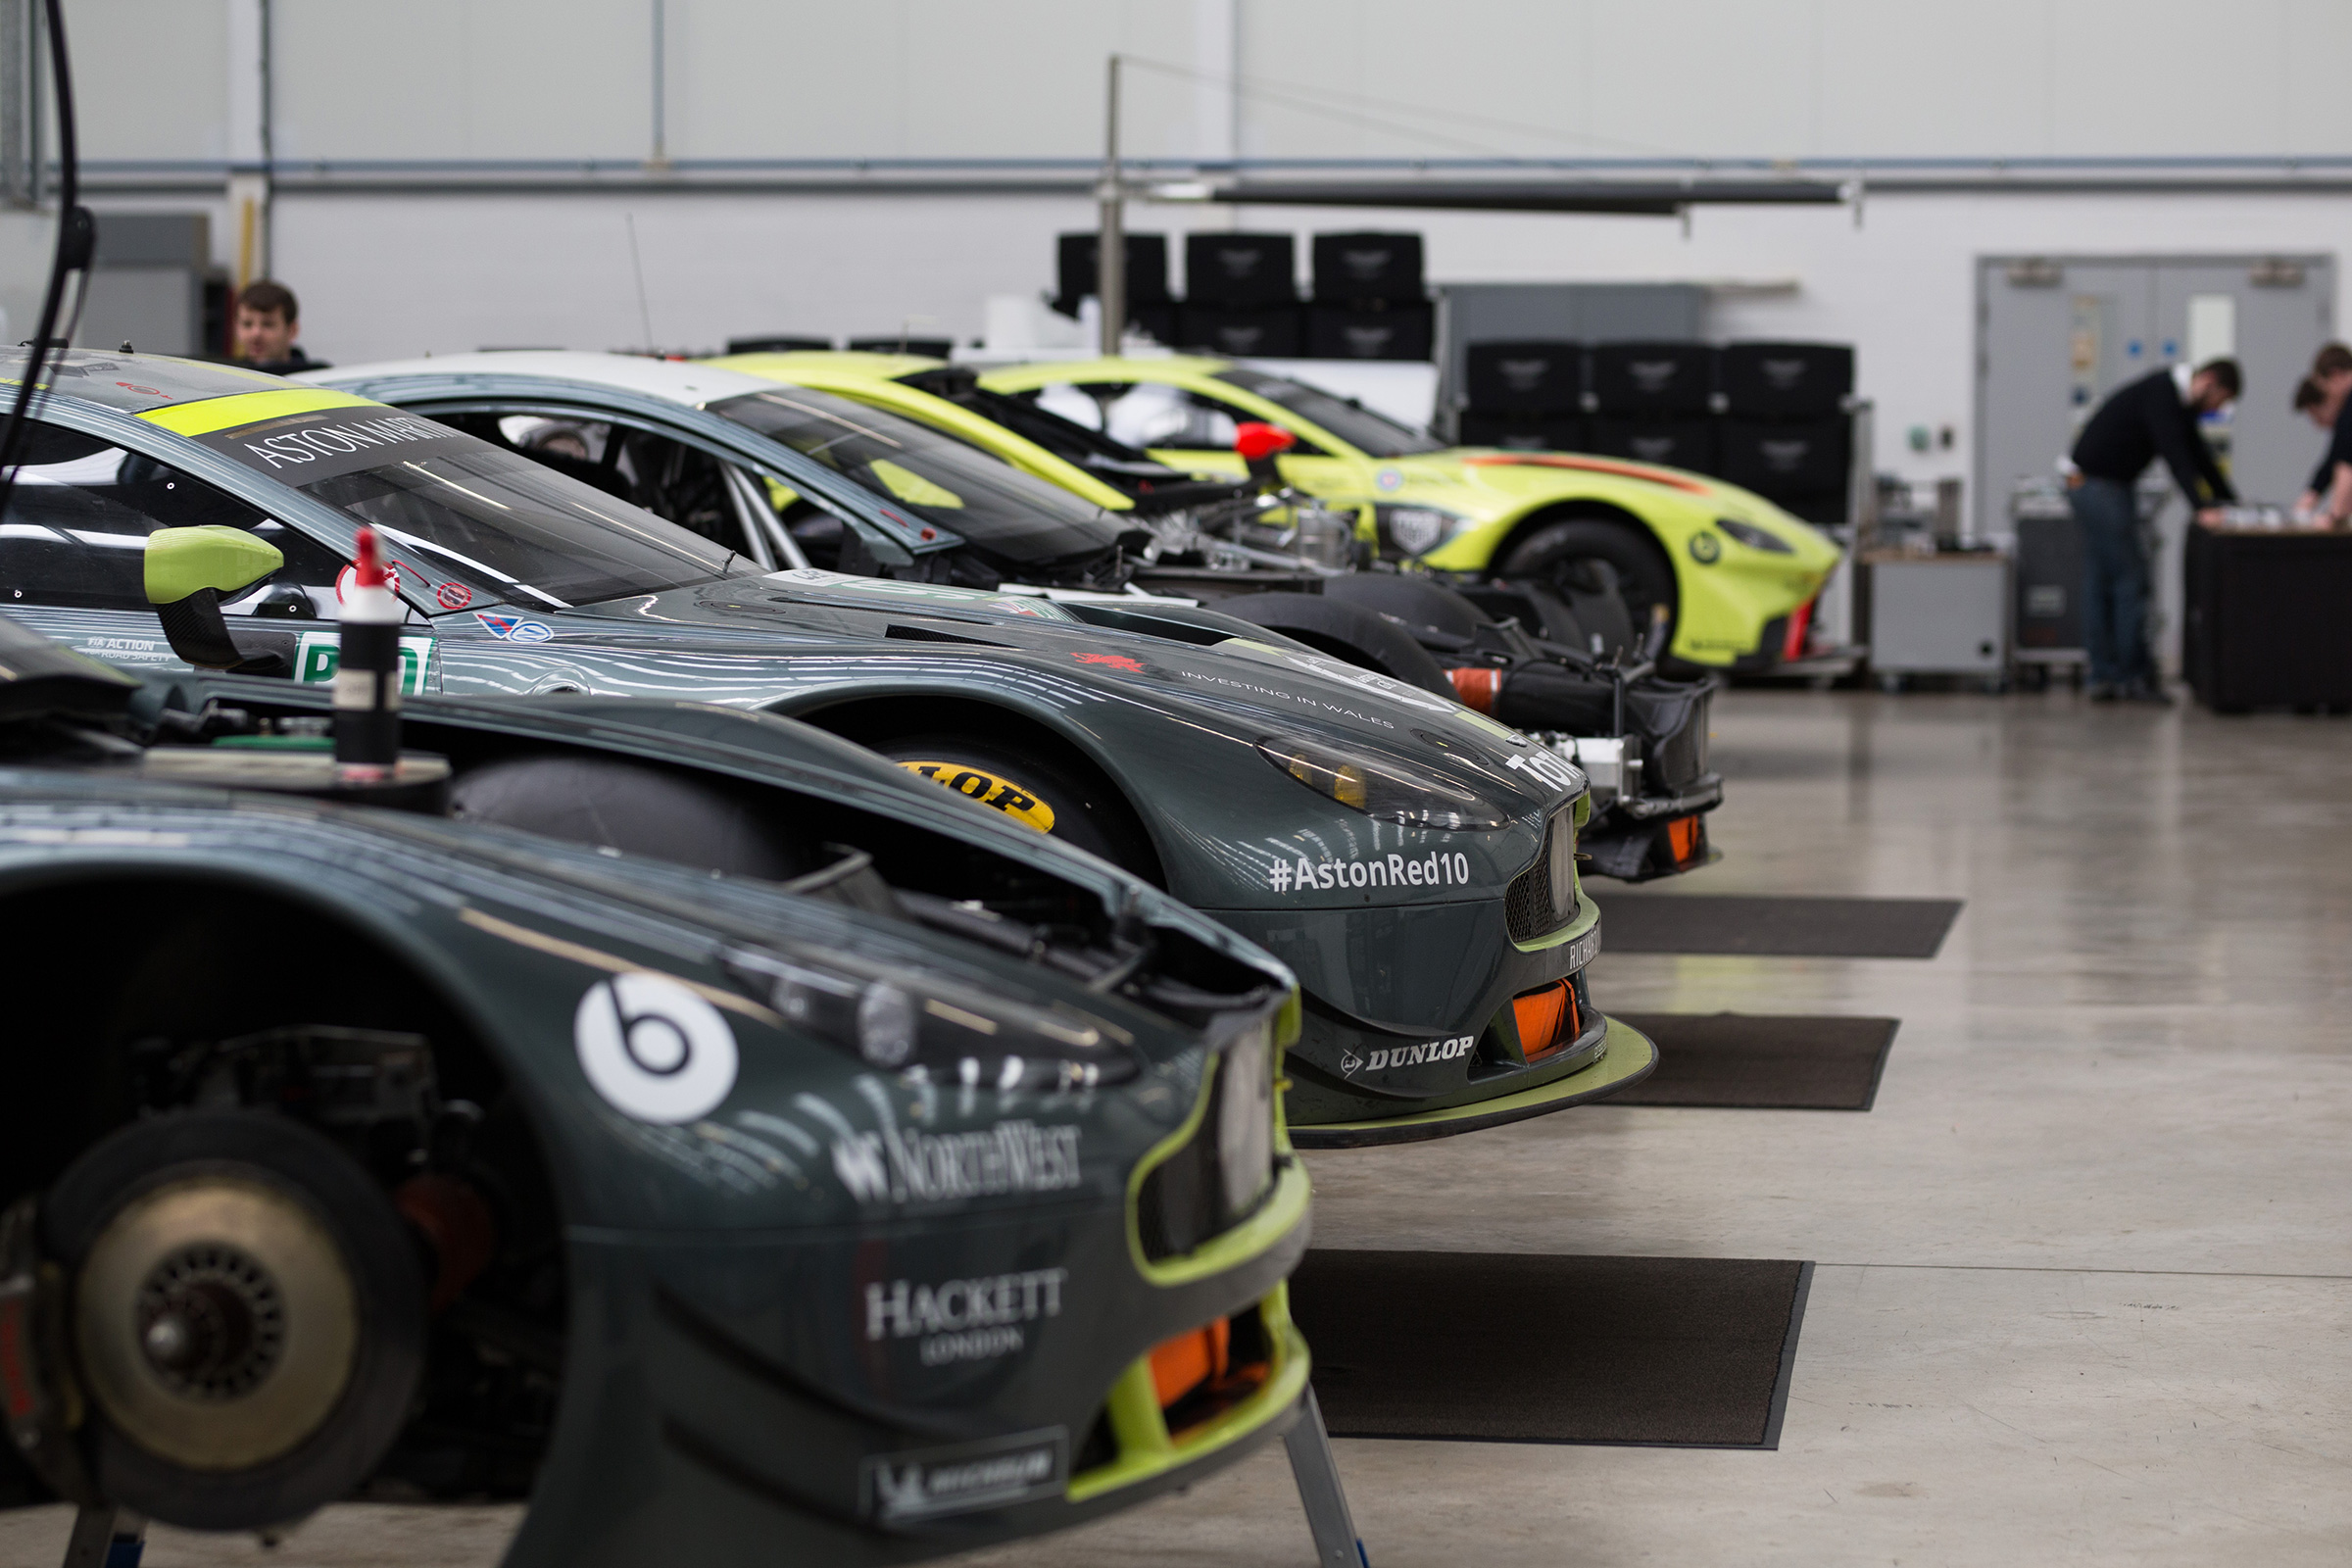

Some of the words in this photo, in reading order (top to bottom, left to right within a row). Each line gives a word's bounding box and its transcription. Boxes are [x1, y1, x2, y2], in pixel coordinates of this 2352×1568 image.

[244, 424, 385, 469] ASTON
[351, 416, 464, 446] MART
[106, 639, 155, 651] ACTION
[1182, 671, 1291, 701] INVESTING
[1297, 696, 1317, 708] IN
[1323, 703, 1396, 730] WALES
[1269, 851, 1470, 893] #AstonRed10
[1365, 1035, 1475, 1072] DUNLOP
[865, 1266, 1070, 1342] HACKETT
